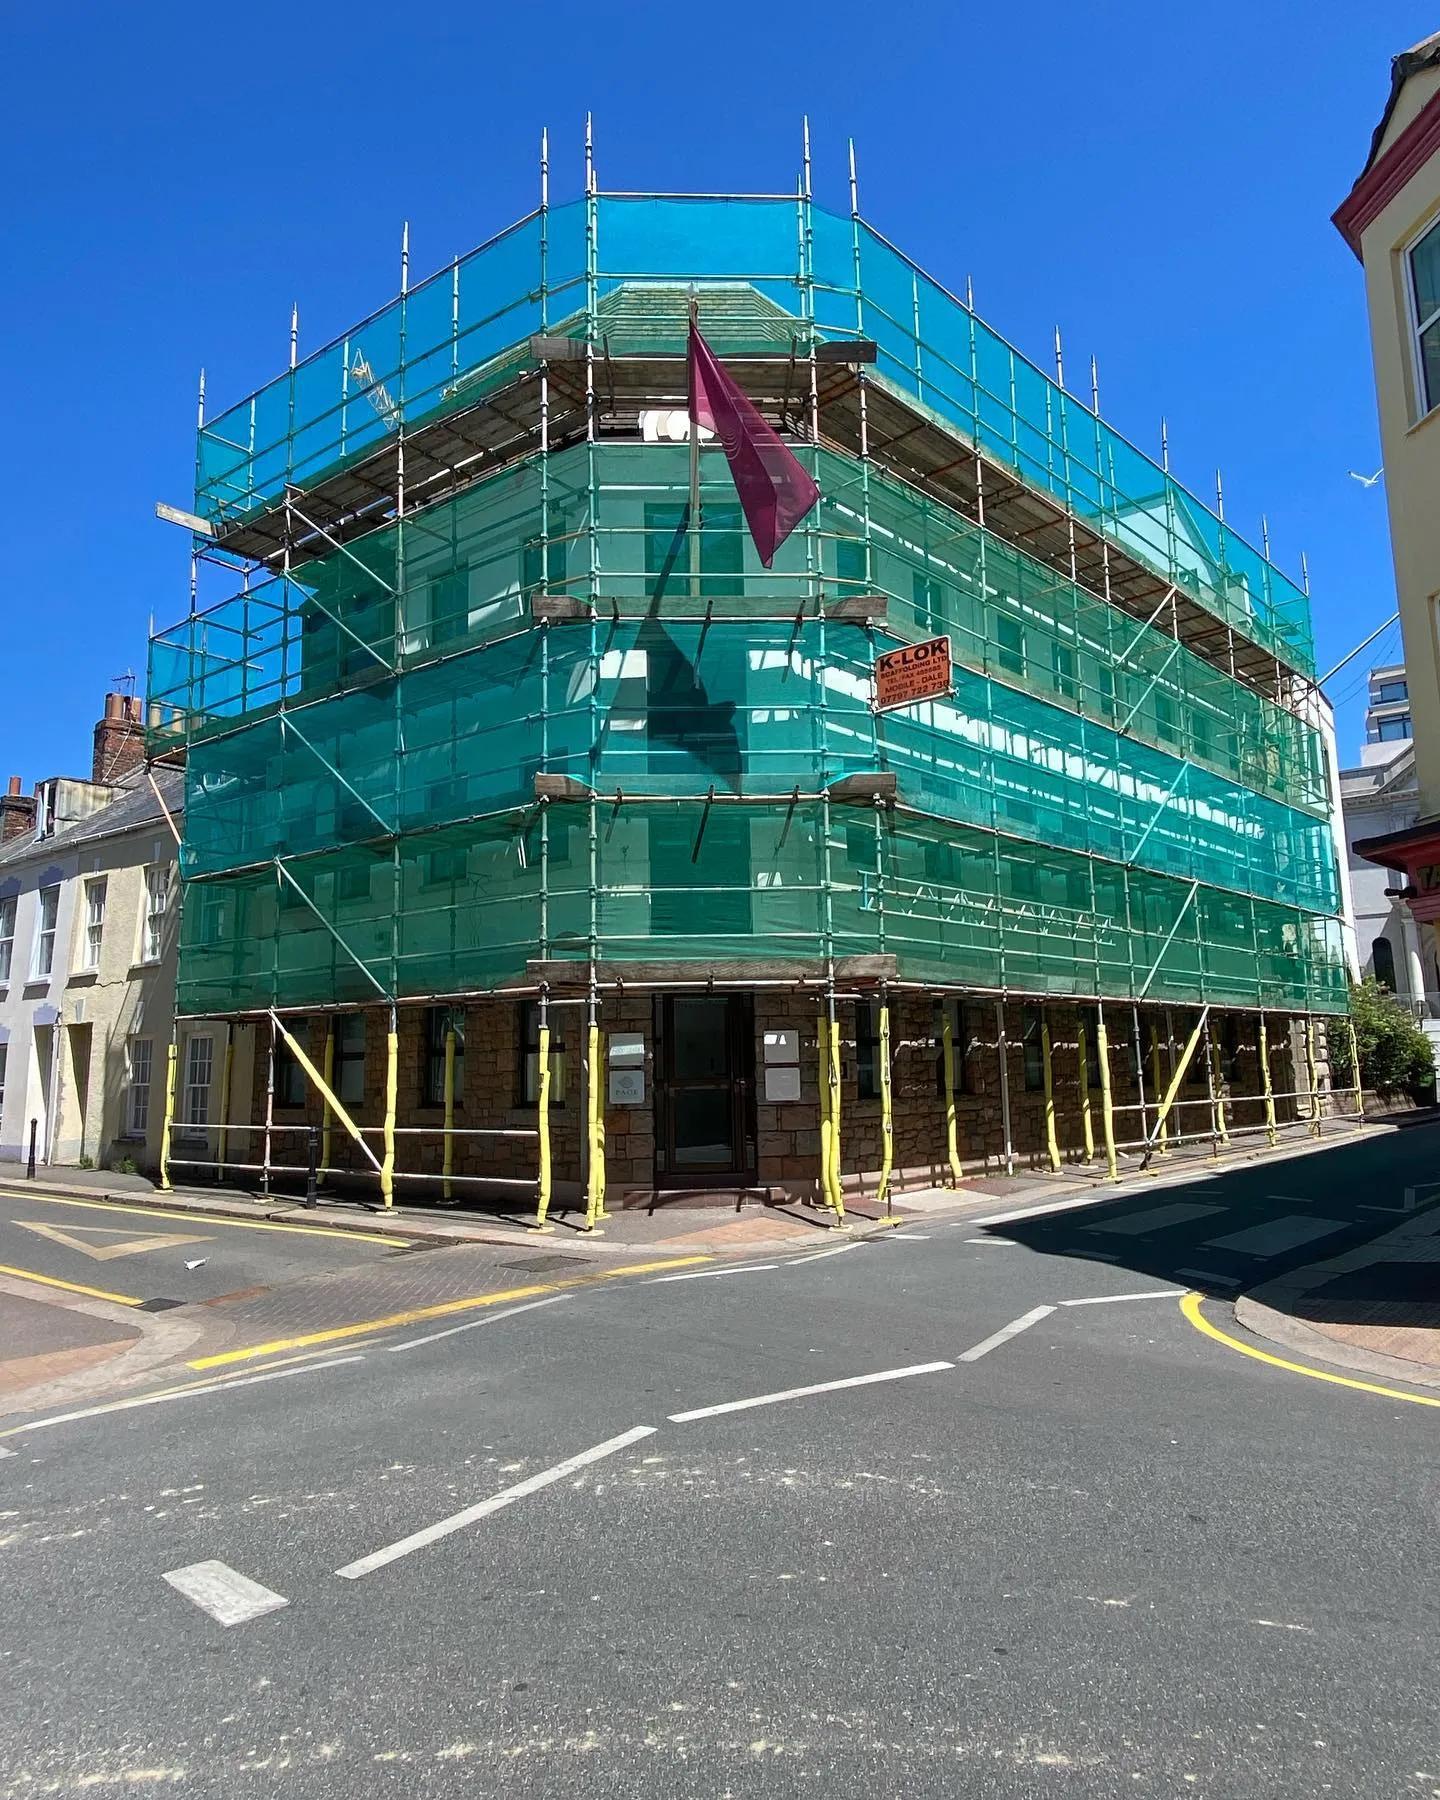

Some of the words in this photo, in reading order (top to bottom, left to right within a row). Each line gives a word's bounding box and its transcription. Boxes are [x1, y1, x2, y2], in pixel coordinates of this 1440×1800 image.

[880, 640, 946, 672] K-LOK
[880, 660, 931, 679] SCAFFOLDING
[932, 655, 947, 664] LTD
[880, 690, 908, 704] 07797
[911, 684, 929, 695] 722
[885, 680, 915, 694] MOBILE
[921, 671, 944, 684] DALE
